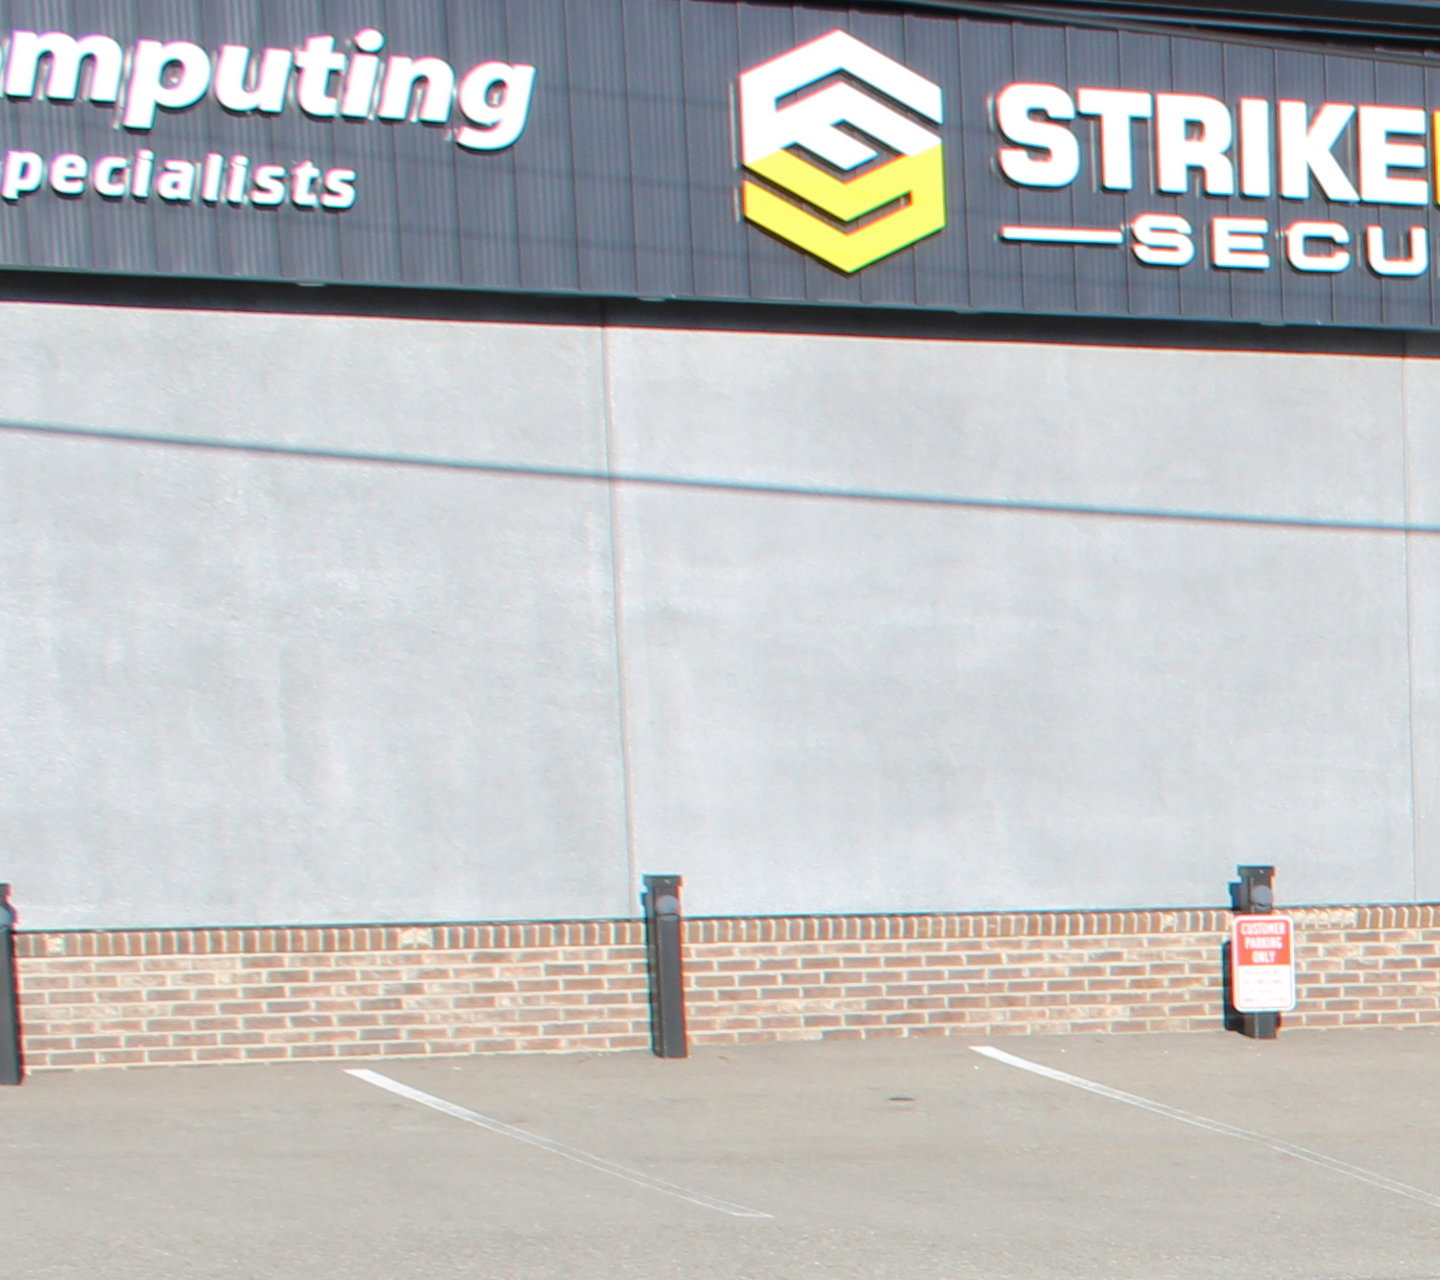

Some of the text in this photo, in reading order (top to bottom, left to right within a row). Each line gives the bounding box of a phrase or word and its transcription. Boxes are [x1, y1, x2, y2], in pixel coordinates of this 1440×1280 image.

[0, 29, 537, 151] mputing
[0, 149, 357, 209] pecialists
[1241, 922, 1286, 935] CUSTOMER
[1245, 937, 1283, 949] PARKING
[1252, 951, 1276, 963] ONLY
